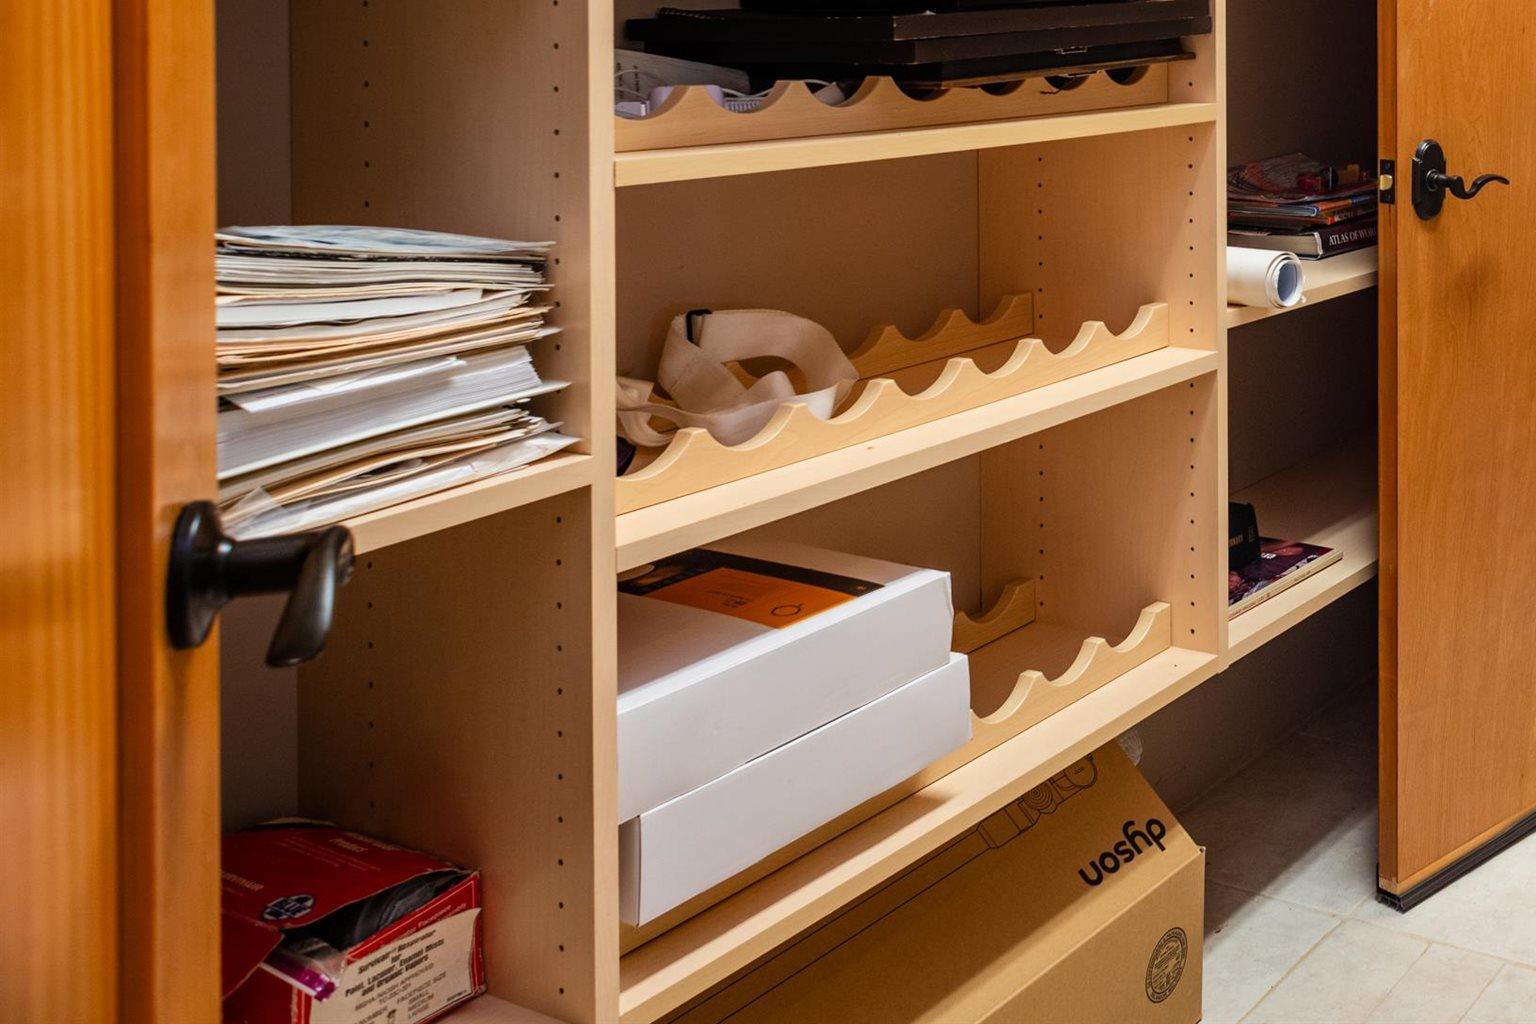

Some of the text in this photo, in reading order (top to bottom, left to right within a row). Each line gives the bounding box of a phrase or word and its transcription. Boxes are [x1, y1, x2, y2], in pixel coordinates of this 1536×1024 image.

[1329, 233, 1350, 246] ATLAS
[1349, 230, 1359, 242] OF
[1078, 818, 1166, 887] dyson
